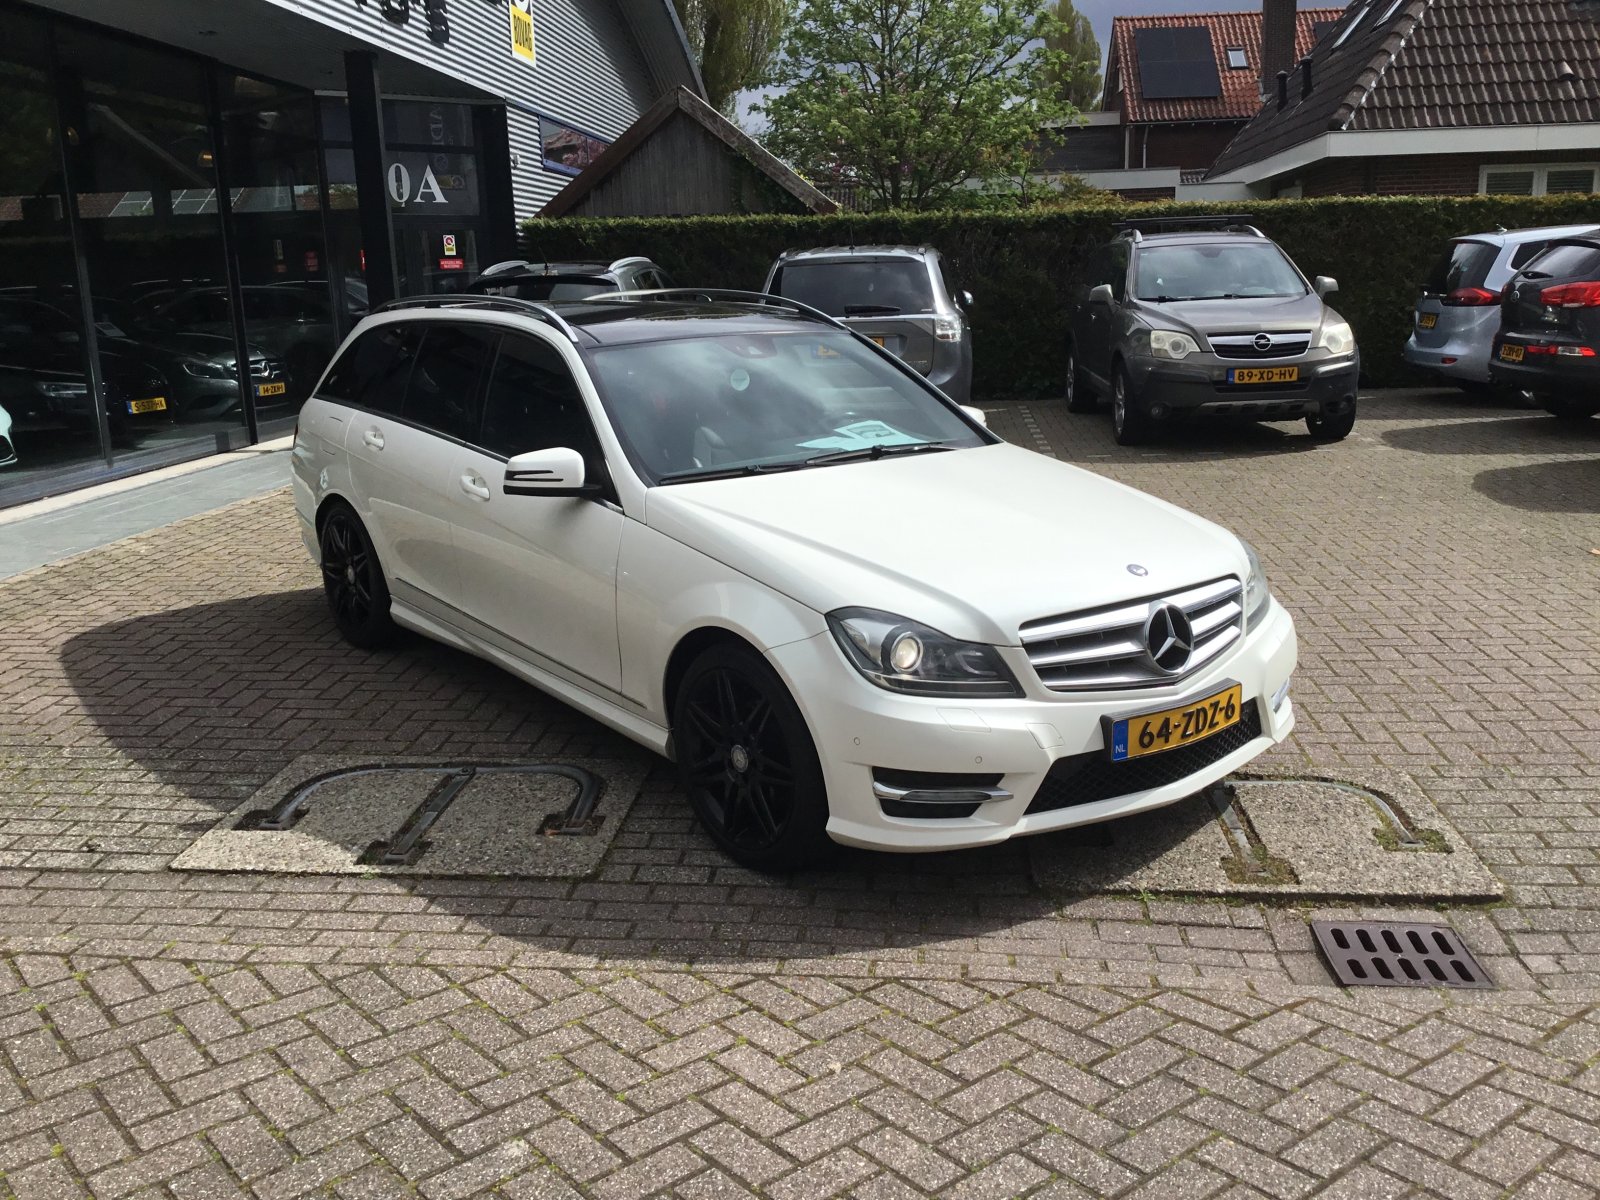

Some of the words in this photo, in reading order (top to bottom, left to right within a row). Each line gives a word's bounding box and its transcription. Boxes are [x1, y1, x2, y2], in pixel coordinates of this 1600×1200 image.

[513, 14, 533, 52] BOVAG
[1237, 368, 1296, 382] 89-XD-HV
[1115, 743, 1126, 754] NL
[1138, 693, 1236, 749] 64-ZDZ-6
